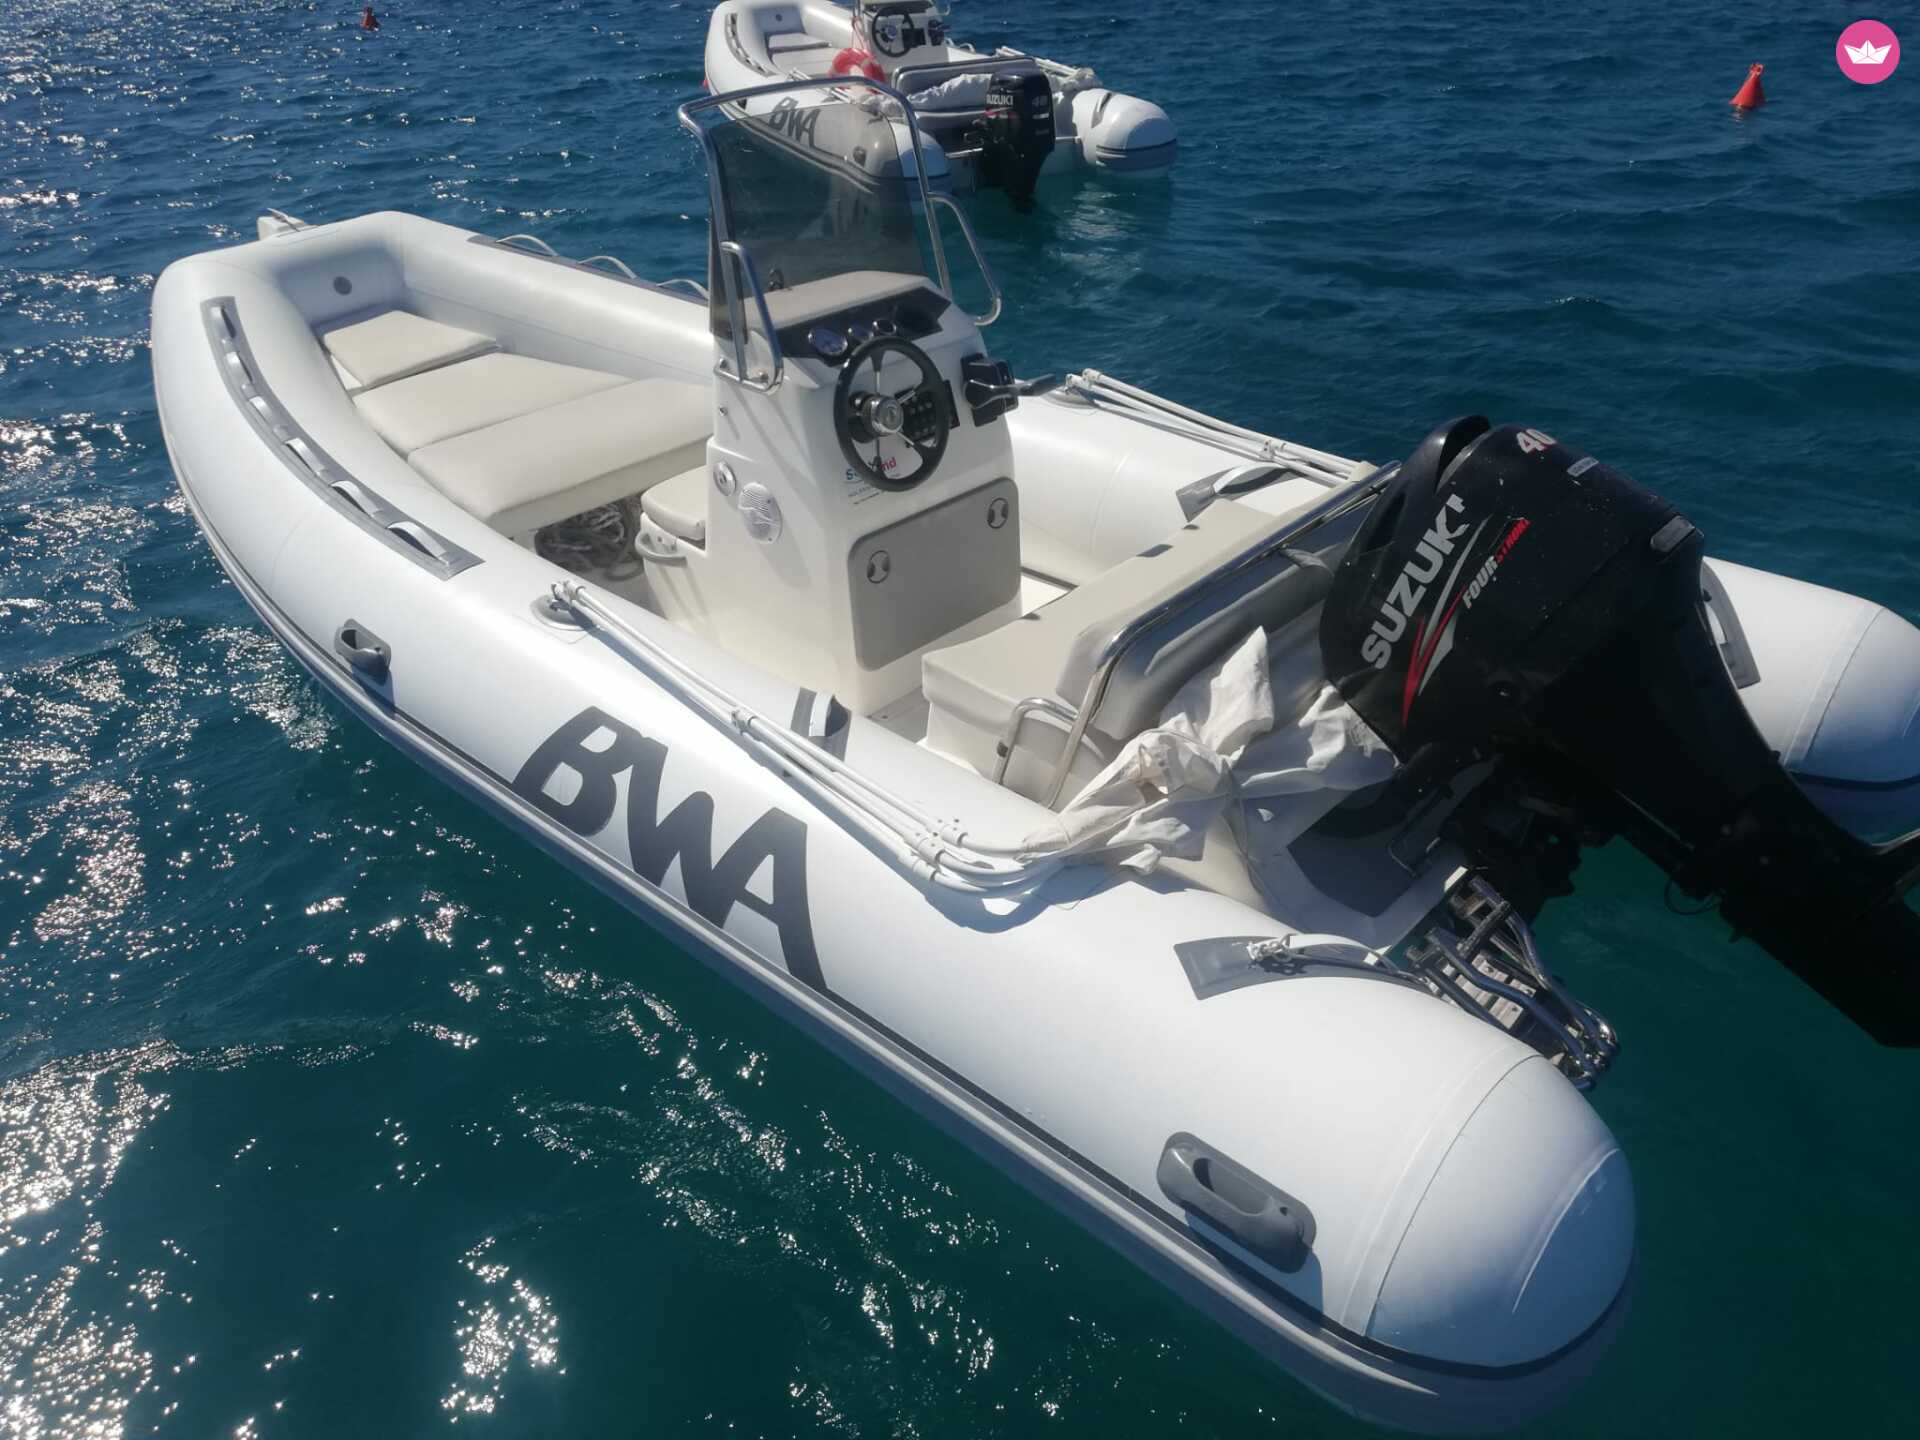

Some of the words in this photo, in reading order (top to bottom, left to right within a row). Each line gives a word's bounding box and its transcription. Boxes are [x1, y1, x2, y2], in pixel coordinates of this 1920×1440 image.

[769, 96, 820, 147] BWA
[1516, 428, 1557, 454] 40
[511, 705, 828, 991] BWA
